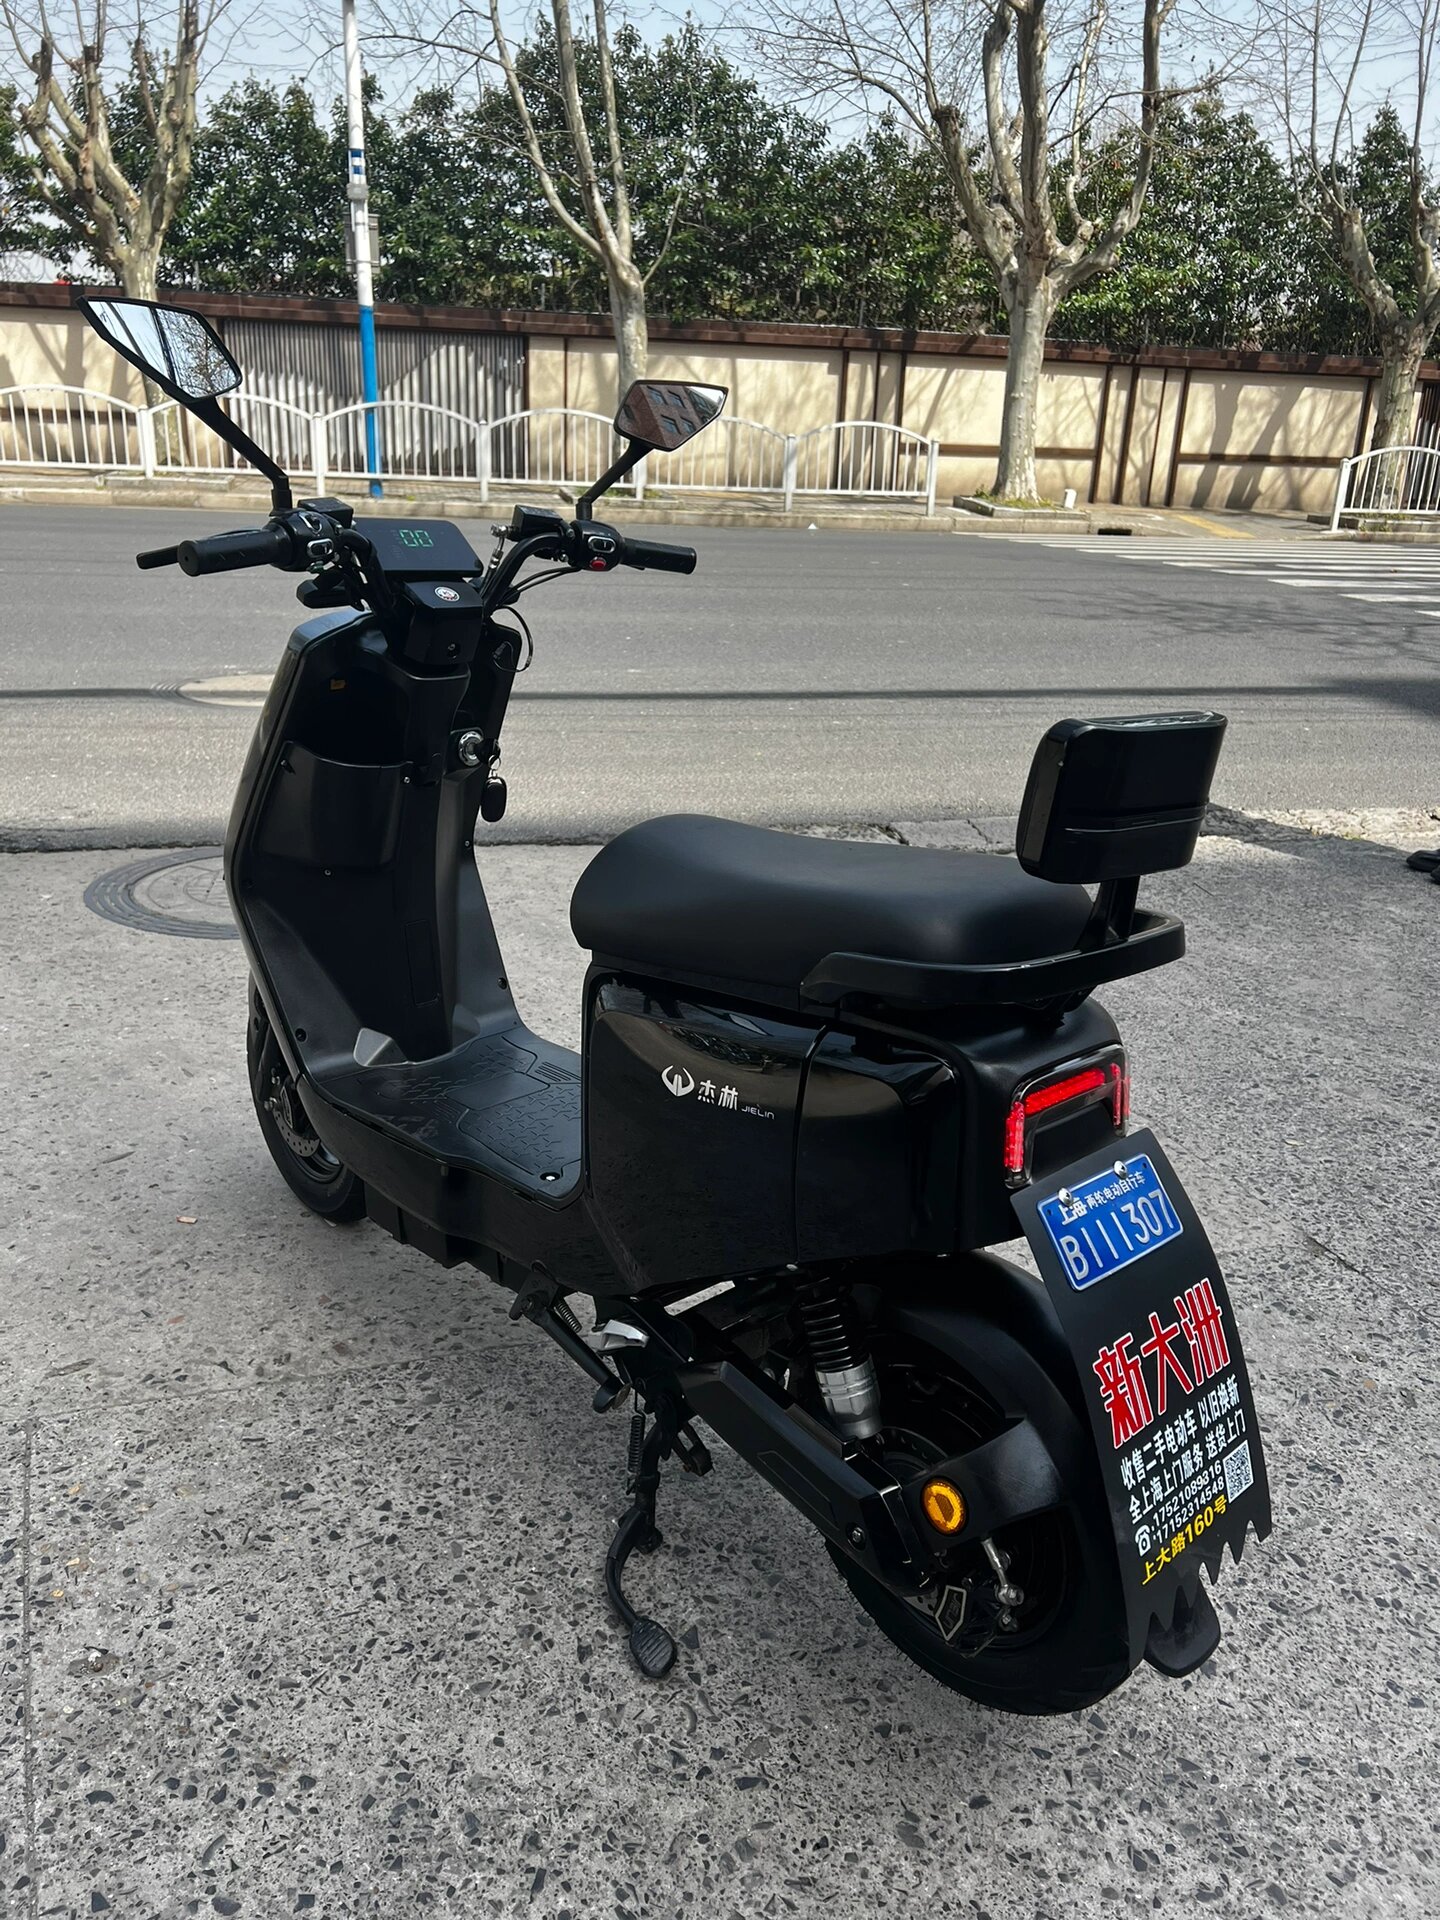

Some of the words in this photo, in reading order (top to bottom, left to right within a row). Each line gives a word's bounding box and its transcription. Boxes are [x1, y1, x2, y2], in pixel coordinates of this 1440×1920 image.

[399, 529, 434, 547] 00
[697, 1080, 738, 1110] 杰林
[741, 1105, 775, 1119] JIELIN
[1058, 1197, 1088, 1225] 上海
[1085, 1171, 1145, 1209] 两轮电动自行车
[1060, 1188, 1174, 1281] B111307
[1092, 1277, 1231, 1449] 新大洲
[1120, 1408, 1198, 1491] 收售二手电动车
[1198, 1374, 1240, 1429] 以旧换新
[1129, 1443, 1205, 1525] 全上海上门服务
[1205, 1408, 1247, 1460] 送货上门
[1142, 1494, 1227, 1585] 上大路160号
